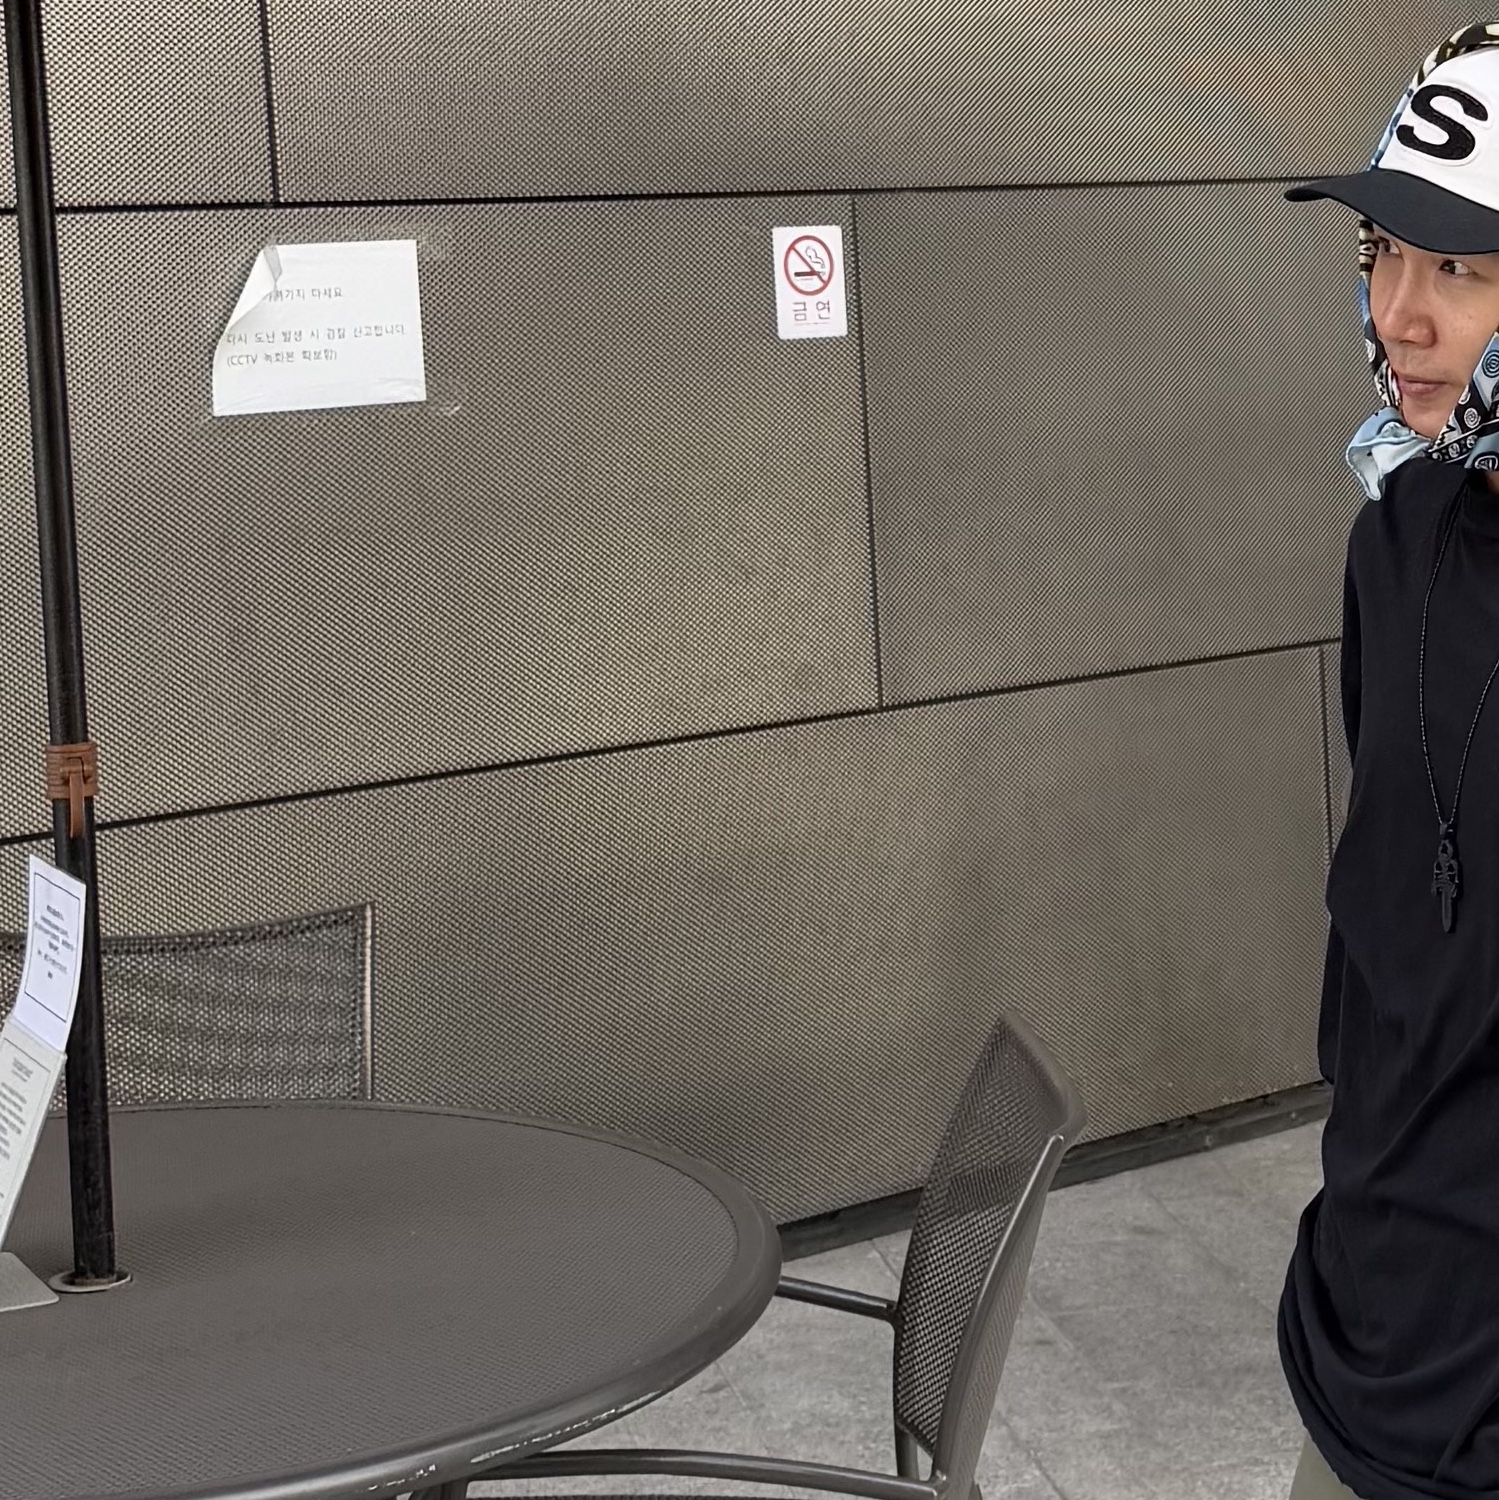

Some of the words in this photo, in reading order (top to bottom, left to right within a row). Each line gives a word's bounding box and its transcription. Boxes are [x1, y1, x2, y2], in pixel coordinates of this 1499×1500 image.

[1395, 84, 1489, 162] S
[792, 300, 831, 322] 금연
[254, 331, 275, 344] 도난
[310, 328, 320, 341] 시
